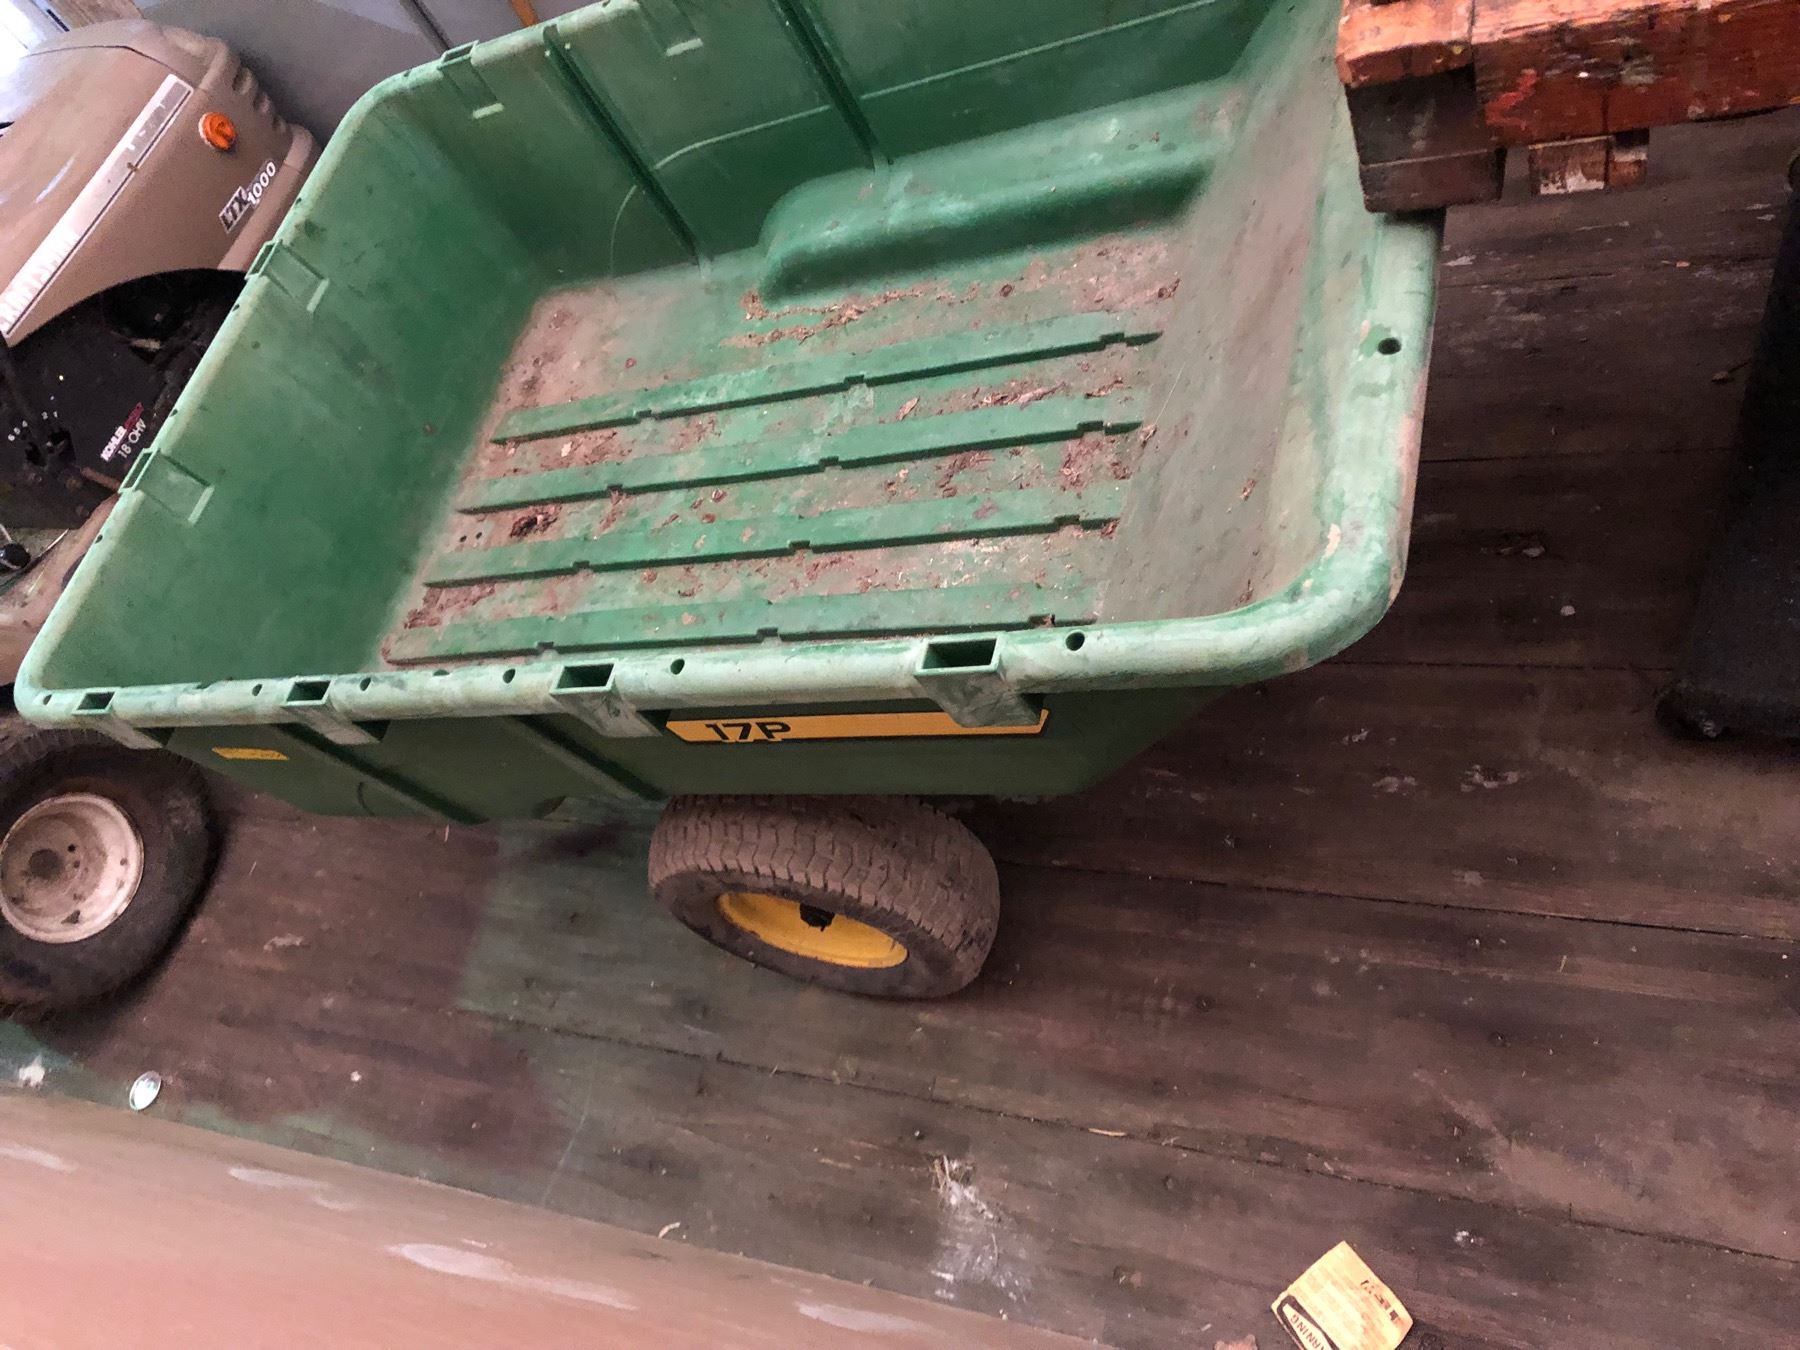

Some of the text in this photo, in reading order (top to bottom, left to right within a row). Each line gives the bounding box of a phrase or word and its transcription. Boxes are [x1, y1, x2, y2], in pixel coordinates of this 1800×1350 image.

[221, 161, 276, 231] LTX 1000
[100, 425, 128, 462] KOHLER
[117, 443, 132, 459] 18
[128, 417, 146, 444] OHV
[704, 721, 792, 741] 17P
[1290, 1313, 1325, 1350] RNING
